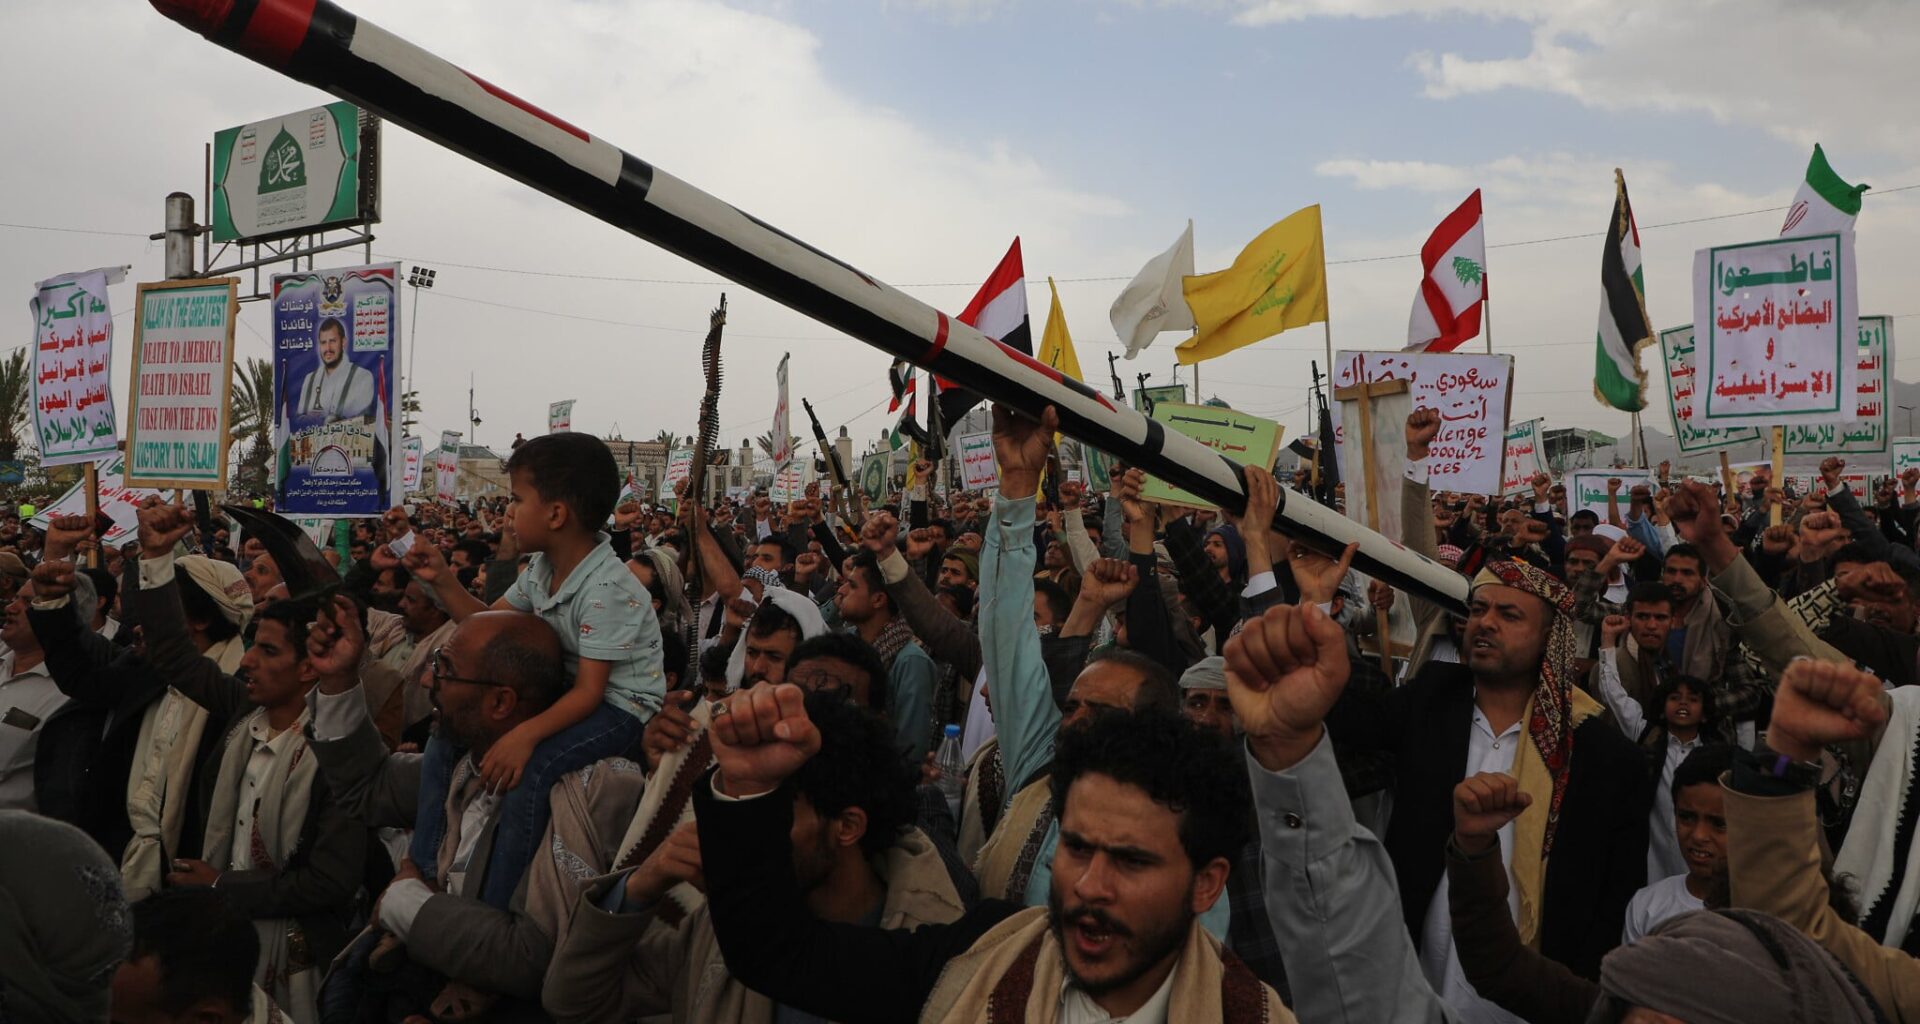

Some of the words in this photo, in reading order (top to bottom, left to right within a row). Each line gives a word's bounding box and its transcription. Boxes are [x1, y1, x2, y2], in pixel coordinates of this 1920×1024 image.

[1717, 250, 1832, 296] قاطعوا
[41, 287, 88, 328] أكبر
[174, 297, 190, 328] THE
[188, 295, 227, 328] GREATEST
[1717, 297, 1775, 335] الأمريكية
[1776, 299, 1832, 331] البضائع
[40, 326, 84, 353] لأمريكا
[142, 342, 168, 364] DEATH
[169, 341, 180, 363] TO
[180, 341, 222, 363] AMERICA
[1765, 337, 1775, 360] و
[38, 357, 85, 385] لإسرائيل
[141, 373, 165, 395] DEATH
[167, 373, 178, 395] TO
[179, 373, 212, 395] ISRAEL
[1715, 370, 1832, 402] الإسرائيلية
[44, 414, 88, 449] للإسلام
[138, 408, 158, 431] CURSE
[159, 407, 178, 430] UPON
[179, 407, 195, 430] THE
[196, 407, 217, 430] JEWS
[1787, 424, 1835, 450] للإسلام
[1838, 421, 1880, 447] النصر
[136, 442, 172, 470] VICTORY
[173, 442, 187, 469] TO
[187, 442, 217, 470] ISLAM
